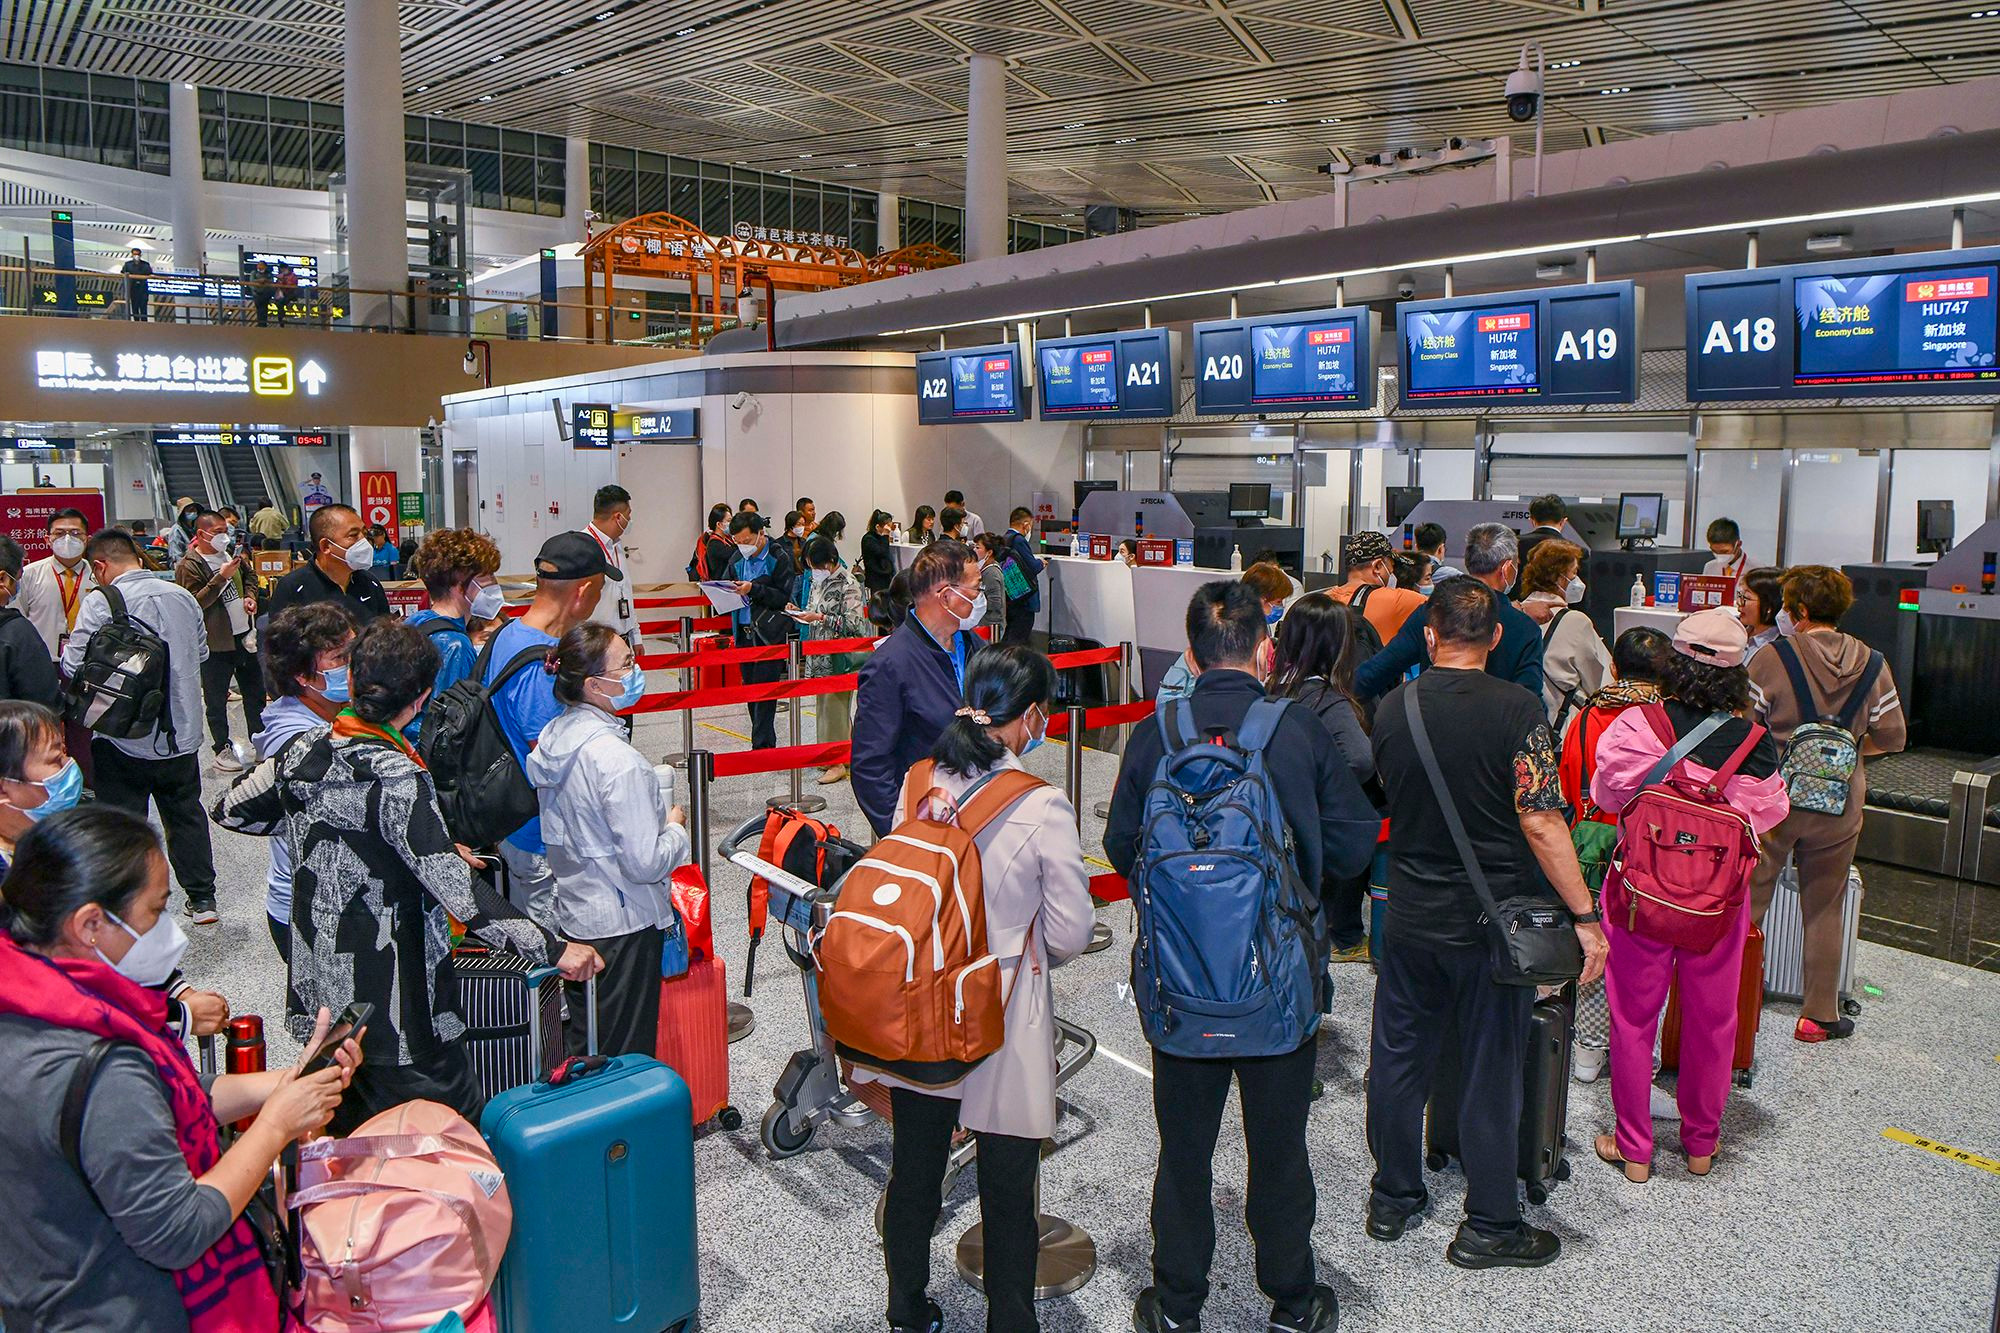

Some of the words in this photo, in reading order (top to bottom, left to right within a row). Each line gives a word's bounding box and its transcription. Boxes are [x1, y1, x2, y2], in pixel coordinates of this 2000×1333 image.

[645, 238, 706, 259] 椰语堂
[1937, 281, 1974, 292] 海南航空
[1819, 304, 1870, 324] 经济舱
[1922, 300, 1969, 317] HU747
[1702, 317, 1776, 355] A18
[1815, 328, 1851, 338] Economy
[1852, 326, 1874, 336] Class
[1923, 323, 1967, 338] 新加坡
[1423, 335, 1456, 350] 经济舱
[1489, 332, 1518, 344] HU747
[1316, 345, 1341, 356] HU747
[1554, 328, 1617, 362] A19
[1922, 341, 1967, 353] Singapore
[1264, 347, 1291, 360] 经济舱
[1420, 353, 1444, 361] Economy
[1490, 349, 1517, 361] 新加坡
[37, 351, 248, 381] 国际、港澳台出发
[1088, 364, 1105, 373] HU747
[1203, 354, 1243, 381] A20
[1318, 360, 1340, 370] 新加坡
[1489, 363, 1518, 373] Singapore
[1126, 361, 1160, 386] A21
[1317, 373, 1341, 381] Singapore
[1090, 376, 1106, 385] 新加坡
[922, 378, 947, 399] A22
[578, 410, 590, 419] A2
[660, 416, 672, 433] A2
[298, 436, 323, 444] 05:46
[367, 497, 392, 505] 麦当劳
[25, 507, 56, 515] 海南航空
[1511, 511, 1530, 519] FISC
